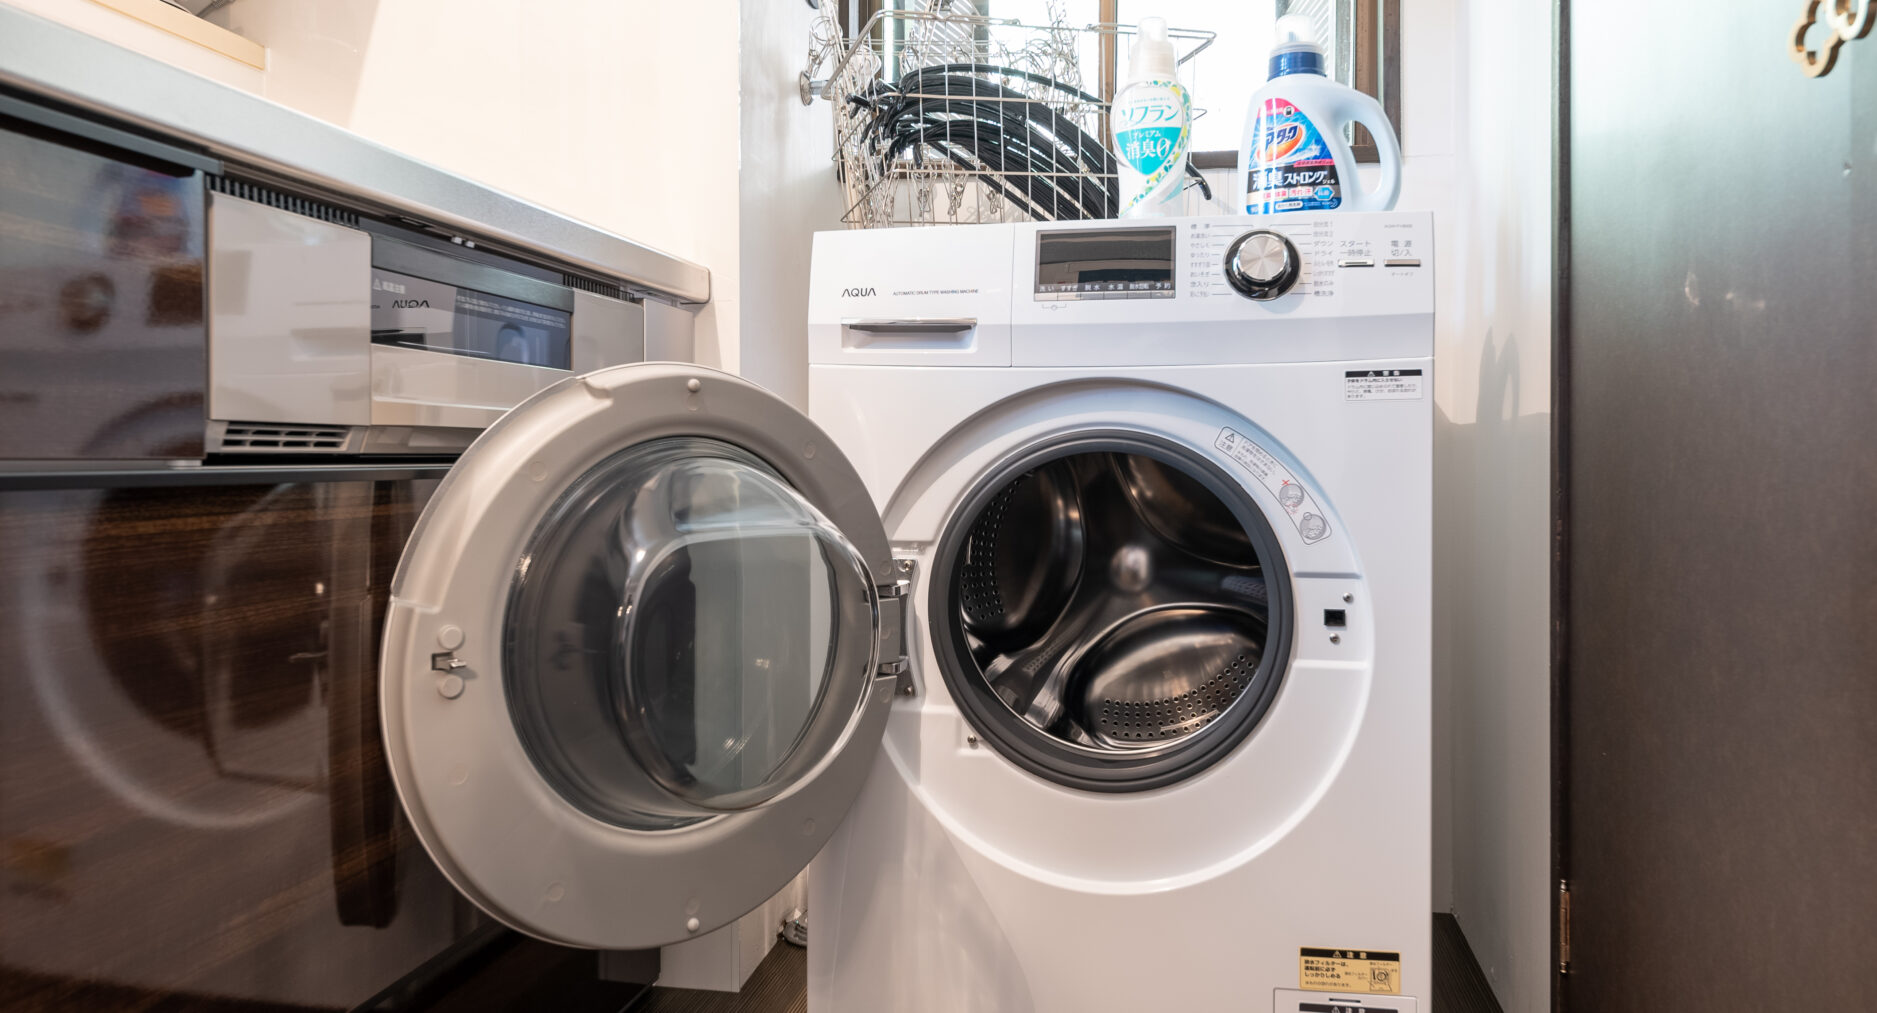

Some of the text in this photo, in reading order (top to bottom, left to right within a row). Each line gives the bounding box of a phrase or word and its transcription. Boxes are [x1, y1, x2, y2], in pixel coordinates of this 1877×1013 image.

[1121, 104, 1179, 126] ソフラン
[1133, 130, 1161, 138] プレミアム
[1265, 125, 1298, 152] アタック
[1340, 249, 1373, 257] 一時停止
[841, 287, 877, 298] AQUA
